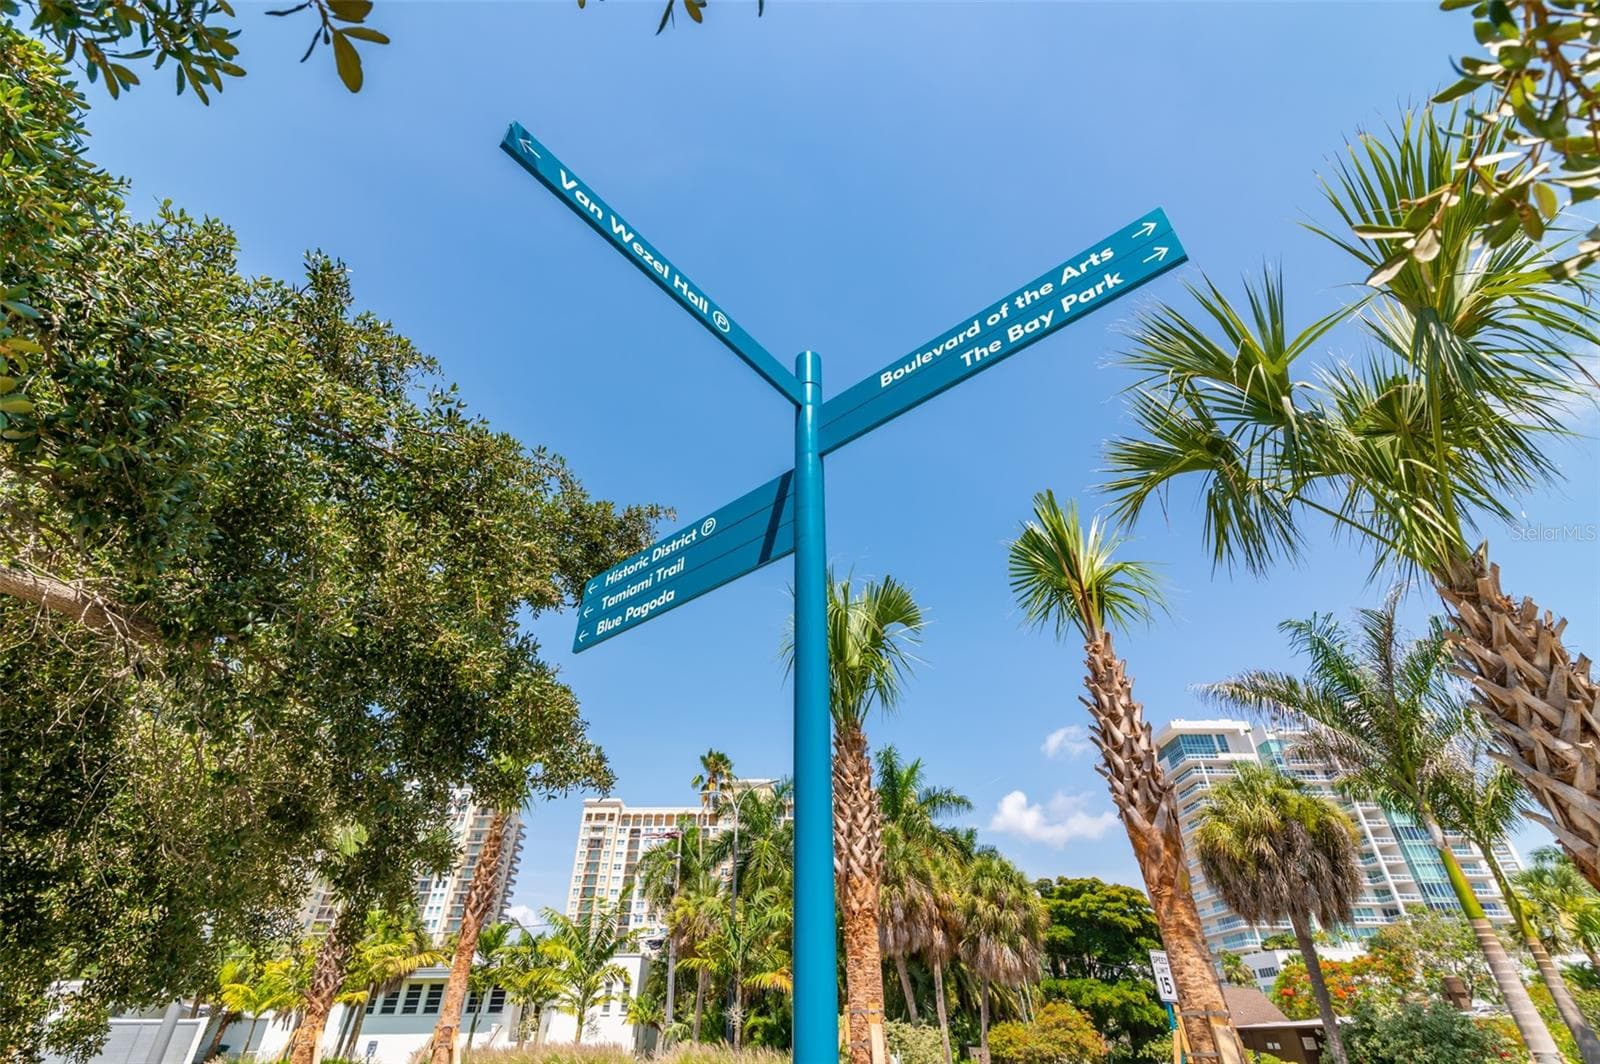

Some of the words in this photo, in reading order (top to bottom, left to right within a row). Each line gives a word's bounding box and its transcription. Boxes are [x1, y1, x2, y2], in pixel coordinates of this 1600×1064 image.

[560, 168, 603, 220] Van
[610, 215, 670, 279] Wezel
[673, 274, 709, 314] Hall
[880, 320, 981, 388] Boulevard
[986, 303, 1009, 326] of
[1014, 282, 1053, 310] the
[1061, 246, 1114, 286] Arts
[960, 338, 1002, 368] The
[1007, 310, 1054, 343] Bay
[1061, 270, 1124, 313] Park
[601, 574, 653, 610] Tamiami
[656, 557, 685, 582] Trail
[605, 556, 649, 587] Historic
[652, 528, 698, 563] District
[596, 614, 622, 636] Blue
[625, 589, 675, 622] Pagoda
[1151, 955, 1167, 965] SPEED
[1160, 977, 1173, 994] 15
